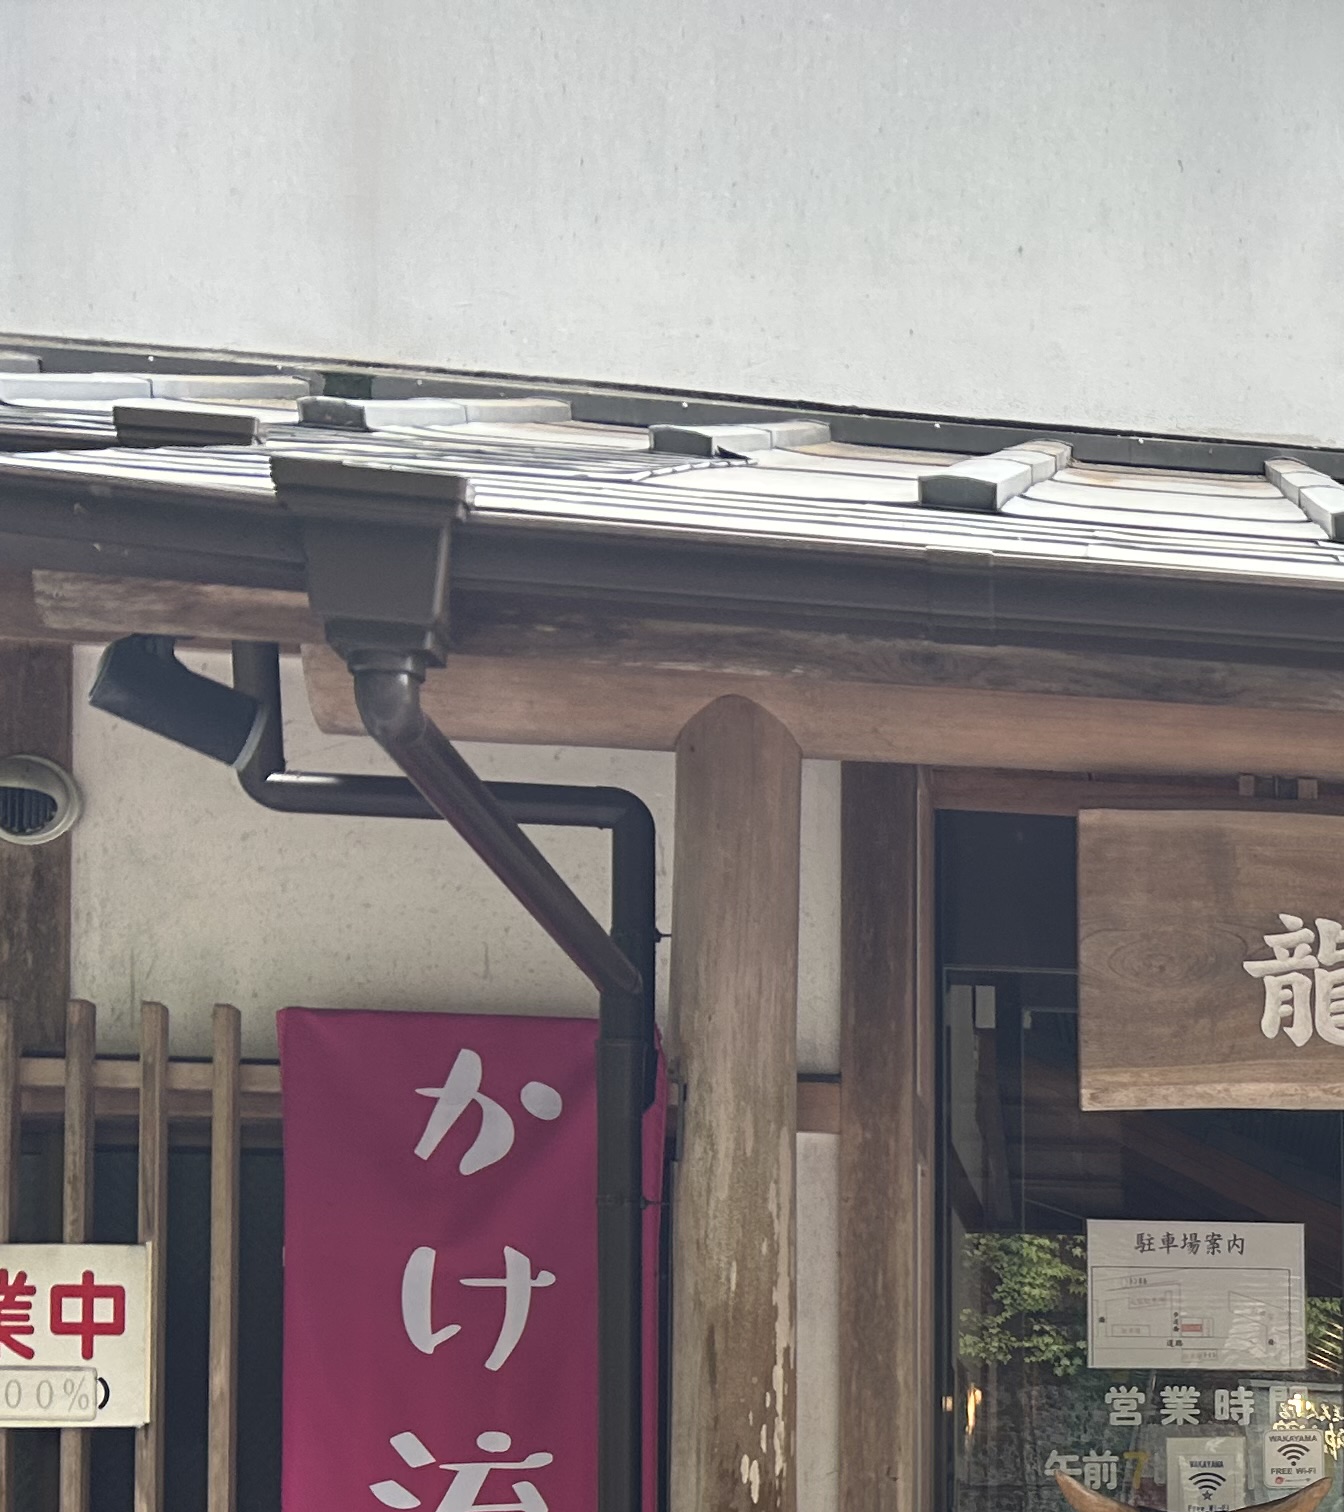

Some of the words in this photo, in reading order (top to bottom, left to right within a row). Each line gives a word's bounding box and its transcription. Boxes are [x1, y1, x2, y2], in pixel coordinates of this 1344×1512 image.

[1134, 1232, 1245, 1255] 駐車場案内
[1268, 1435, 1318, 1443] WAKAYAMA
[1189, 1460, 1224, 1469] WAKAYAMA
[1044, 1449, 1166, 1490] 午前7
[1270, 1467, 1292, 1475] FREE
